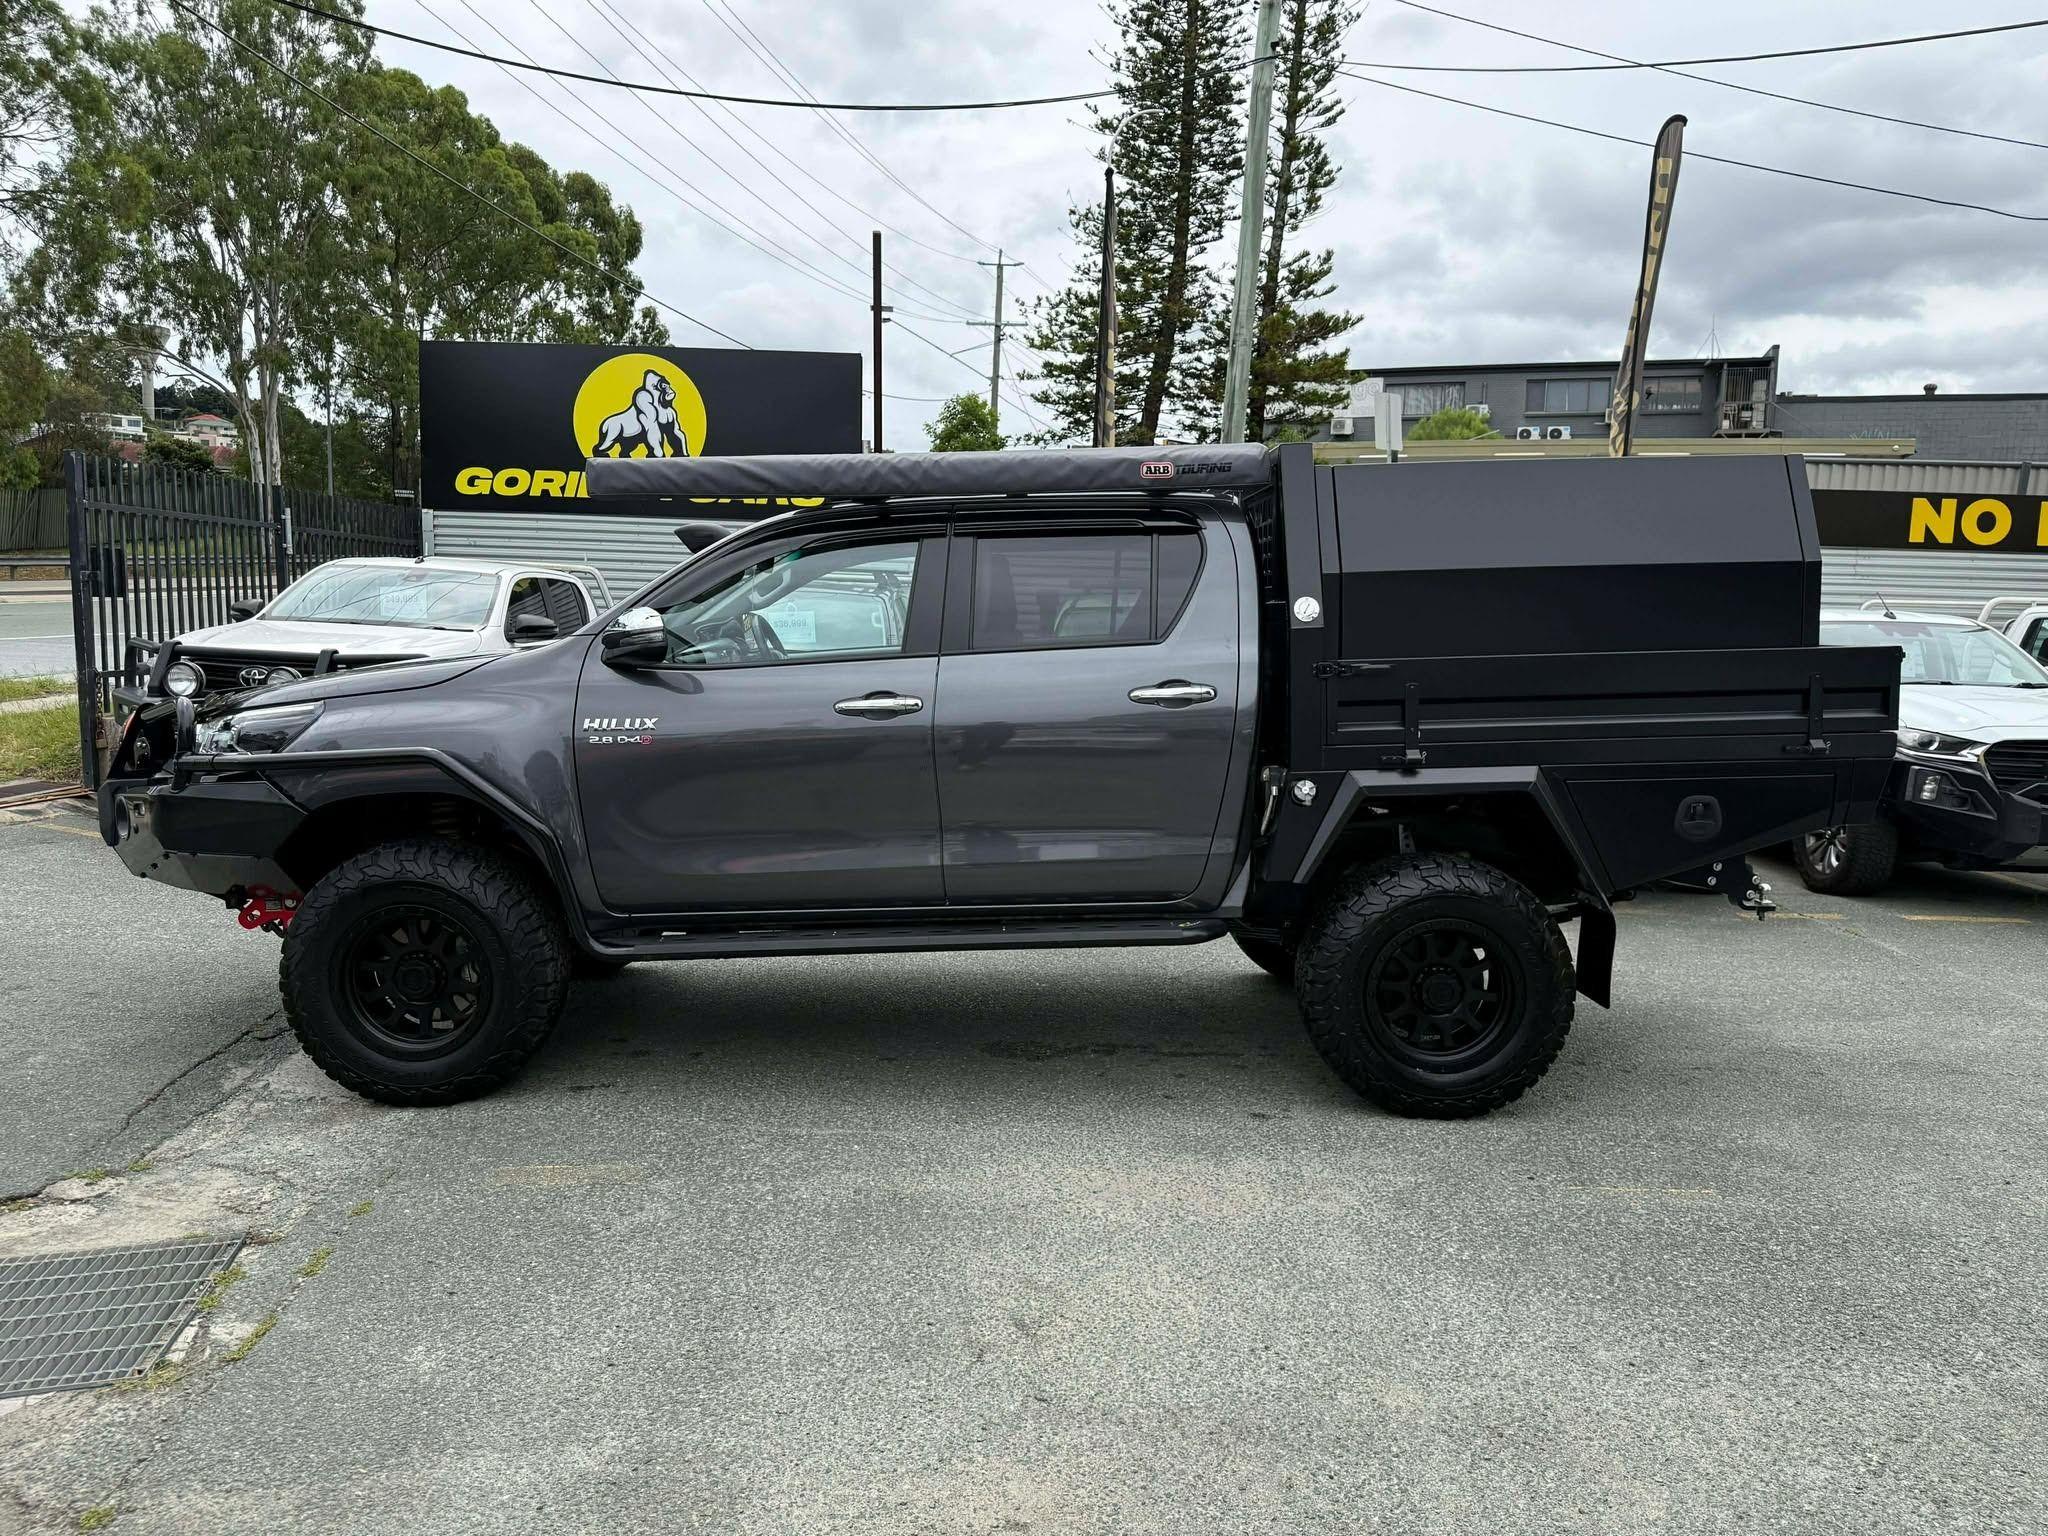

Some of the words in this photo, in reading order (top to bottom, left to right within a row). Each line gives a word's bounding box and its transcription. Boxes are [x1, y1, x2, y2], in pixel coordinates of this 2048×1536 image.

[1143, 464, 1171, 476] ARB
[1175, 462, 1233, 475] TOURING
[1908, 497, 2013, 546] NO
[582, 717, 659, 731] HILUX
[617, 735, 653, 745] D-4D
